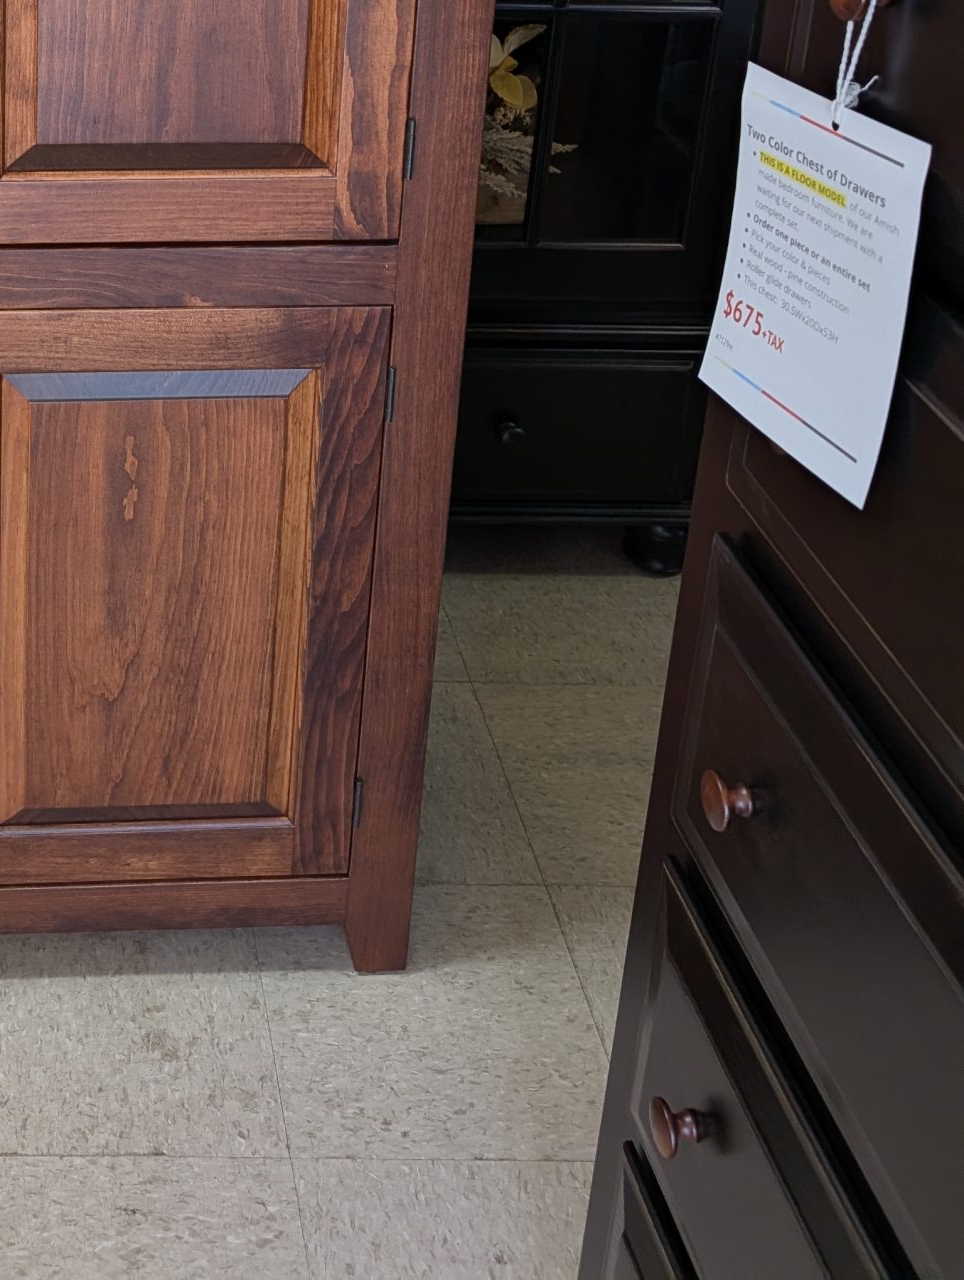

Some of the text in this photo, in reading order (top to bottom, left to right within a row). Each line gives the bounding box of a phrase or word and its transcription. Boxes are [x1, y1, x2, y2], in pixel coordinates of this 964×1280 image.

[747, 124, 886, 208] Two Color Chest of Drawers
[759, 151, 776, 168] THIS
[777, 163, 785, 173] IS
[784, 167, 791, 177] A
[792, 169, 817, 191] FLOOR
[849, 201, 859, 214] of
[858, 207, 873, 222] our
[874, 214, 900, 236] Amish
[755, 199, 786, 225] complete
[757, 184, 780, 206] waiting
[781, 197, 792, 211] for
[792, 203, 806, 217] our
[806, 211, 822, 229] next
[823, 220, 859, 250] shipment
[860, 241, 877, 260] with
[758, 168, 777, 186] made
[778, 178, 810, 202] bedroom
[847, 217, 859, 232] We
[860, 226, 873, 240] are
[743, 274, 757, 290] This
[746, 260, 812, 310] Roller glide drawers
[749, 243, 764, 260] Real
[764, 253, 783, 273] wood
[787, 270, 804, 286] pine
[805, 280, 850, 315] construction
[751, 228, 765, 244] Pick
[764, 236, 781, 253] your
[782, 245, 803, 266] color
[808, 265, 831, 286] pieces
[753, 214, 870, 292] Order one piece or an entire set
